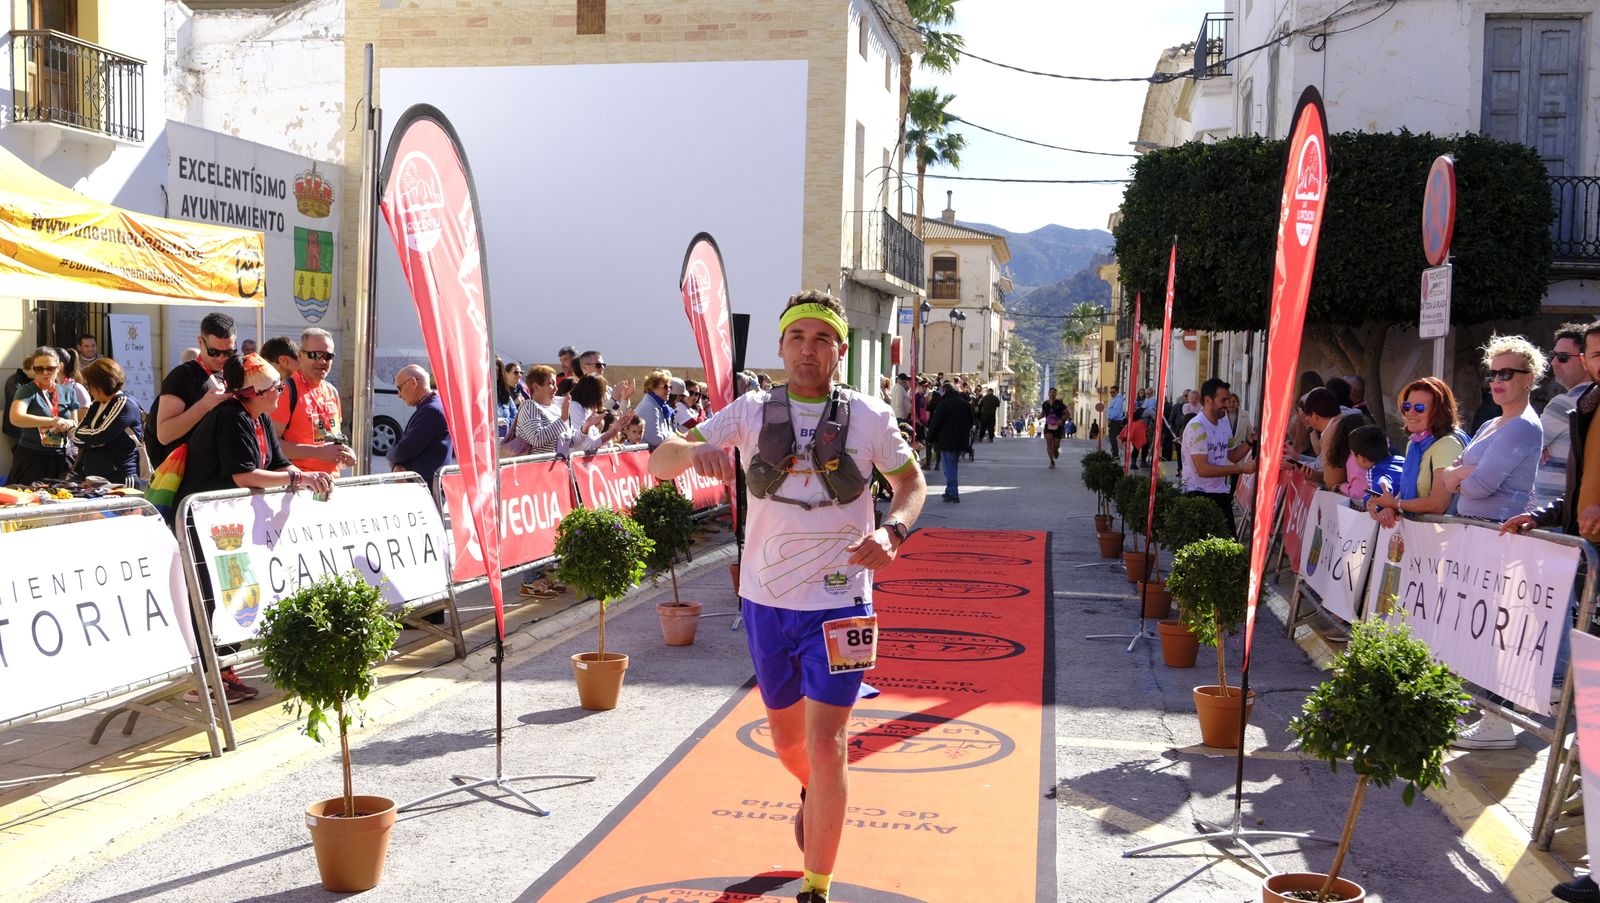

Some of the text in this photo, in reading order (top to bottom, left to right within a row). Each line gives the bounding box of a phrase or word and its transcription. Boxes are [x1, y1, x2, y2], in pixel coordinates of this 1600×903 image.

[179, 155, 286, 201] EXCELENTÍSIMO
[181, 194, 284, 233] AYUNTAMIENTO
[266, 511, 427, 548] AYUNTAMIENTO DE
[0, 557, 151, 605] IENTO DE
[269, 533, 437, 594] CANTORIA
[1533, 584, 1555, 609] DE
[846, 628, 873, 646] 86
[1397, 581, 1549, 666] CANTORIA
[866, 676, 937, 684] Canto
[741, 799, 940, 820] de Caoria
